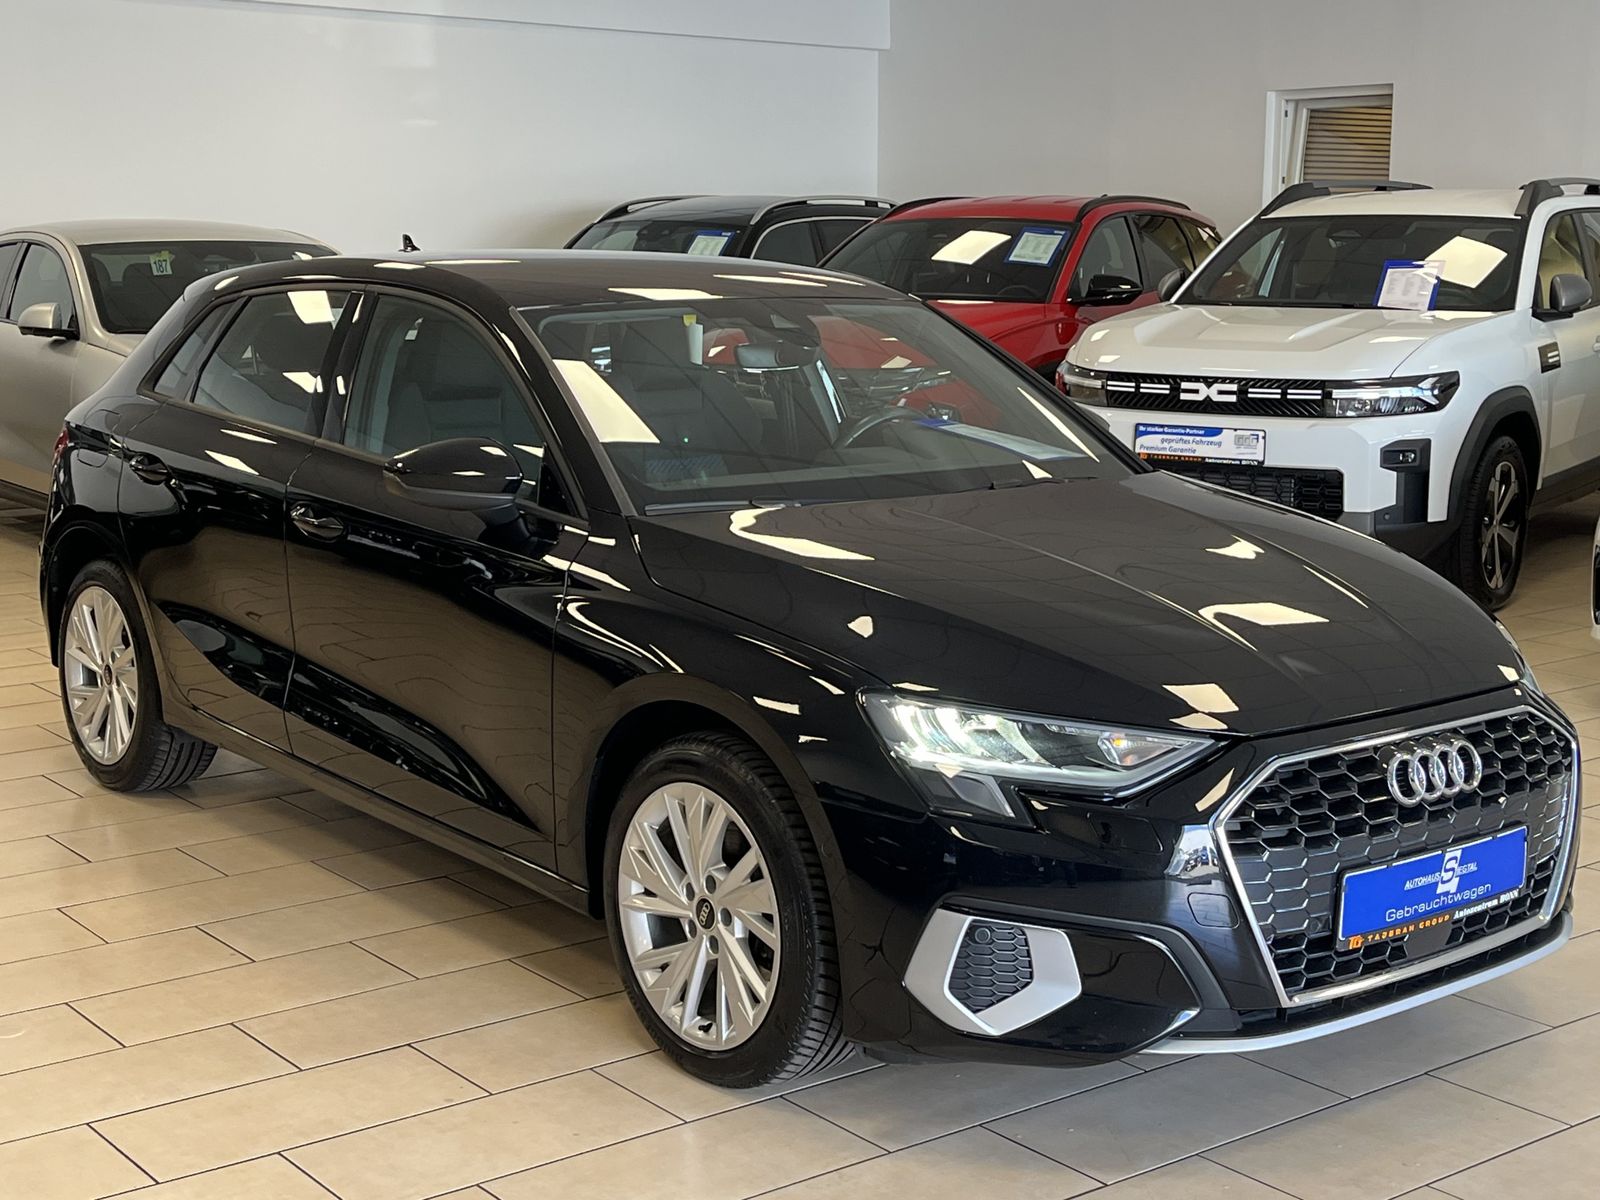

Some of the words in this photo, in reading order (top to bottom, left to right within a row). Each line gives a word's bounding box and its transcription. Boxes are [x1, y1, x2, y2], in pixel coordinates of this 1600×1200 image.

[153, 259, 169, 274] 187
[1139, 444, 1168, 452] Premium
[1168, 445, 1197, 454] Garantie
[1160, 437, 1191, 445] geprüftes
[1192, 439, 1223, 448] Fahrzeug
[1404, 872, 1442, 891] AUTOHAUS
[1385, 884, 1492, 922] Gebrauchtwagen
[1419, 914, 1450, 929] GROUP
[1453, 899, 1498, 919] Autozentrum
[1499, 889, 1519, 904] BONN
